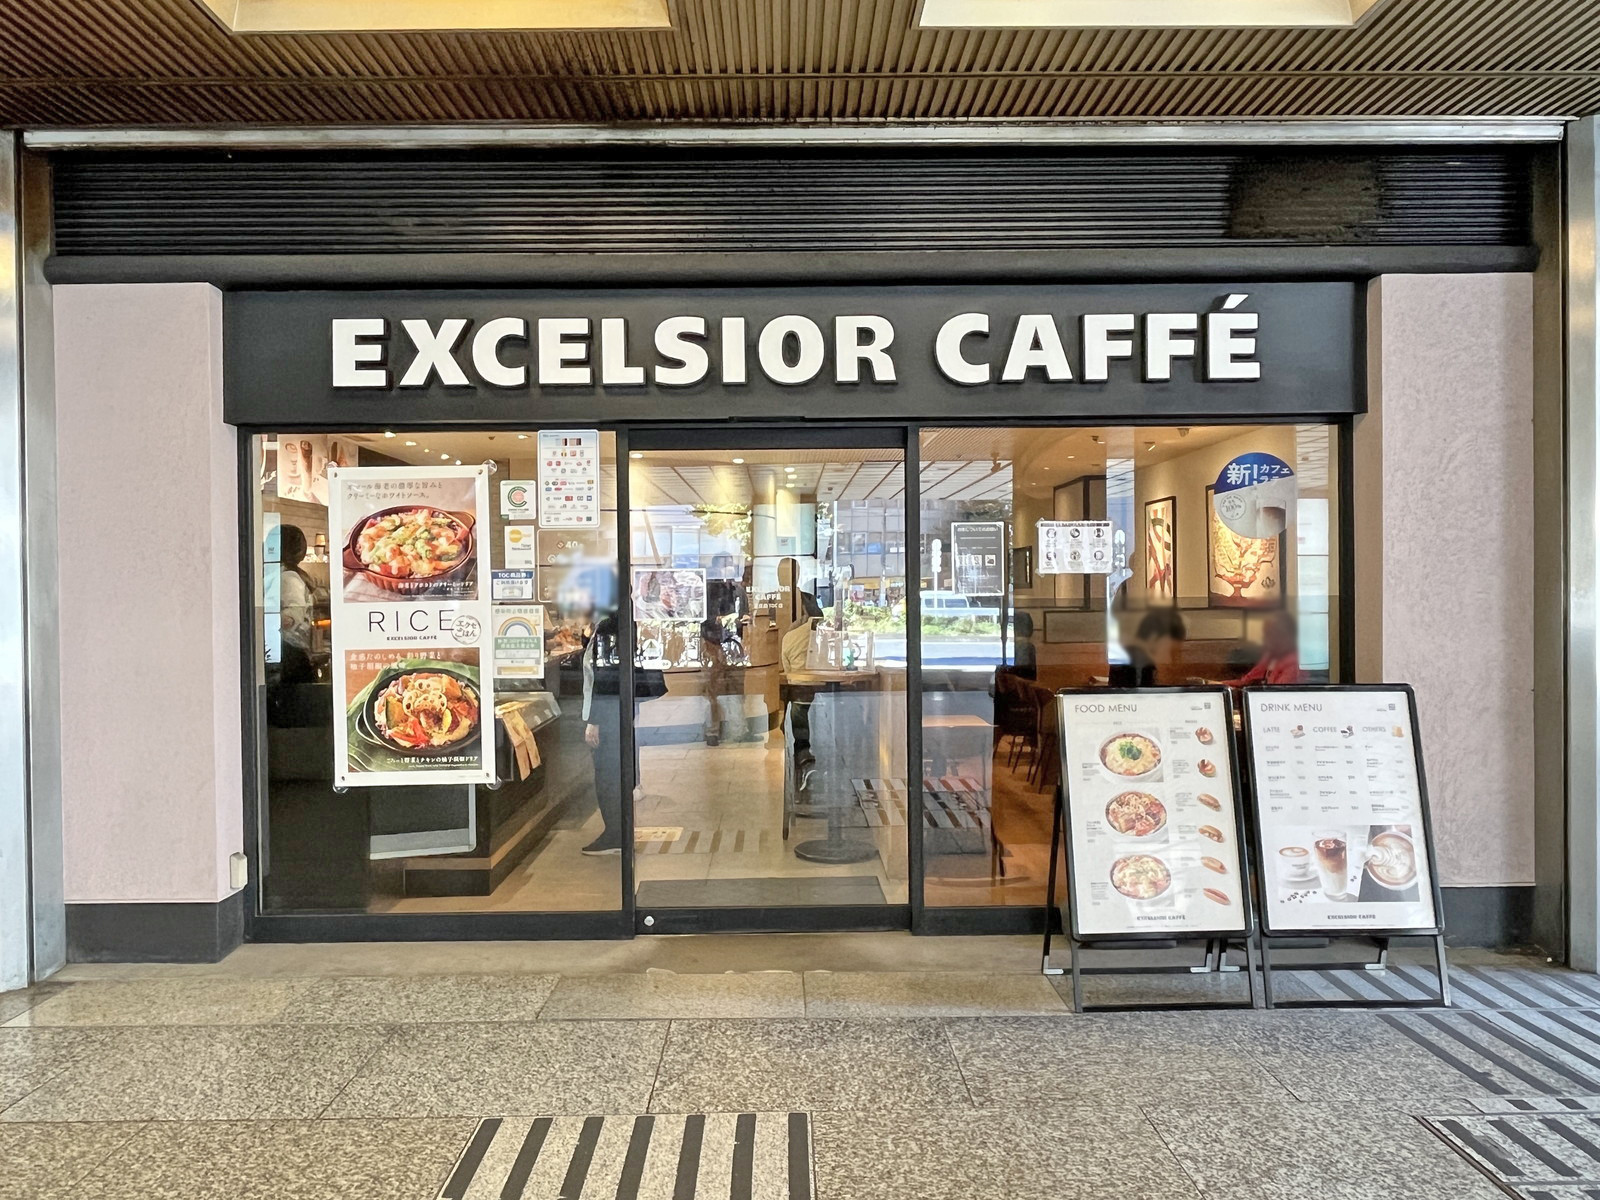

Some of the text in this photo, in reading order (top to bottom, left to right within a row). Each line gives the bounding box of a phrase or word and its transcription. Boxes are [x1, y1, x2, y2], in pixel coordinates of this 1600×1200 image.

[332, 294, 1261, 387] EXCELSIOR CAFFÉ
[1260, 464, 1290, 474] カフェ
[368, 609, 455, 633] RICE
[456, 620, 478, 629] エクセ
[455, 628, 478, 638] ごはん
[1074, 703, 1138, 713] FOOD MENU
[1260, 703, 1323, 712] DRINK MENU
